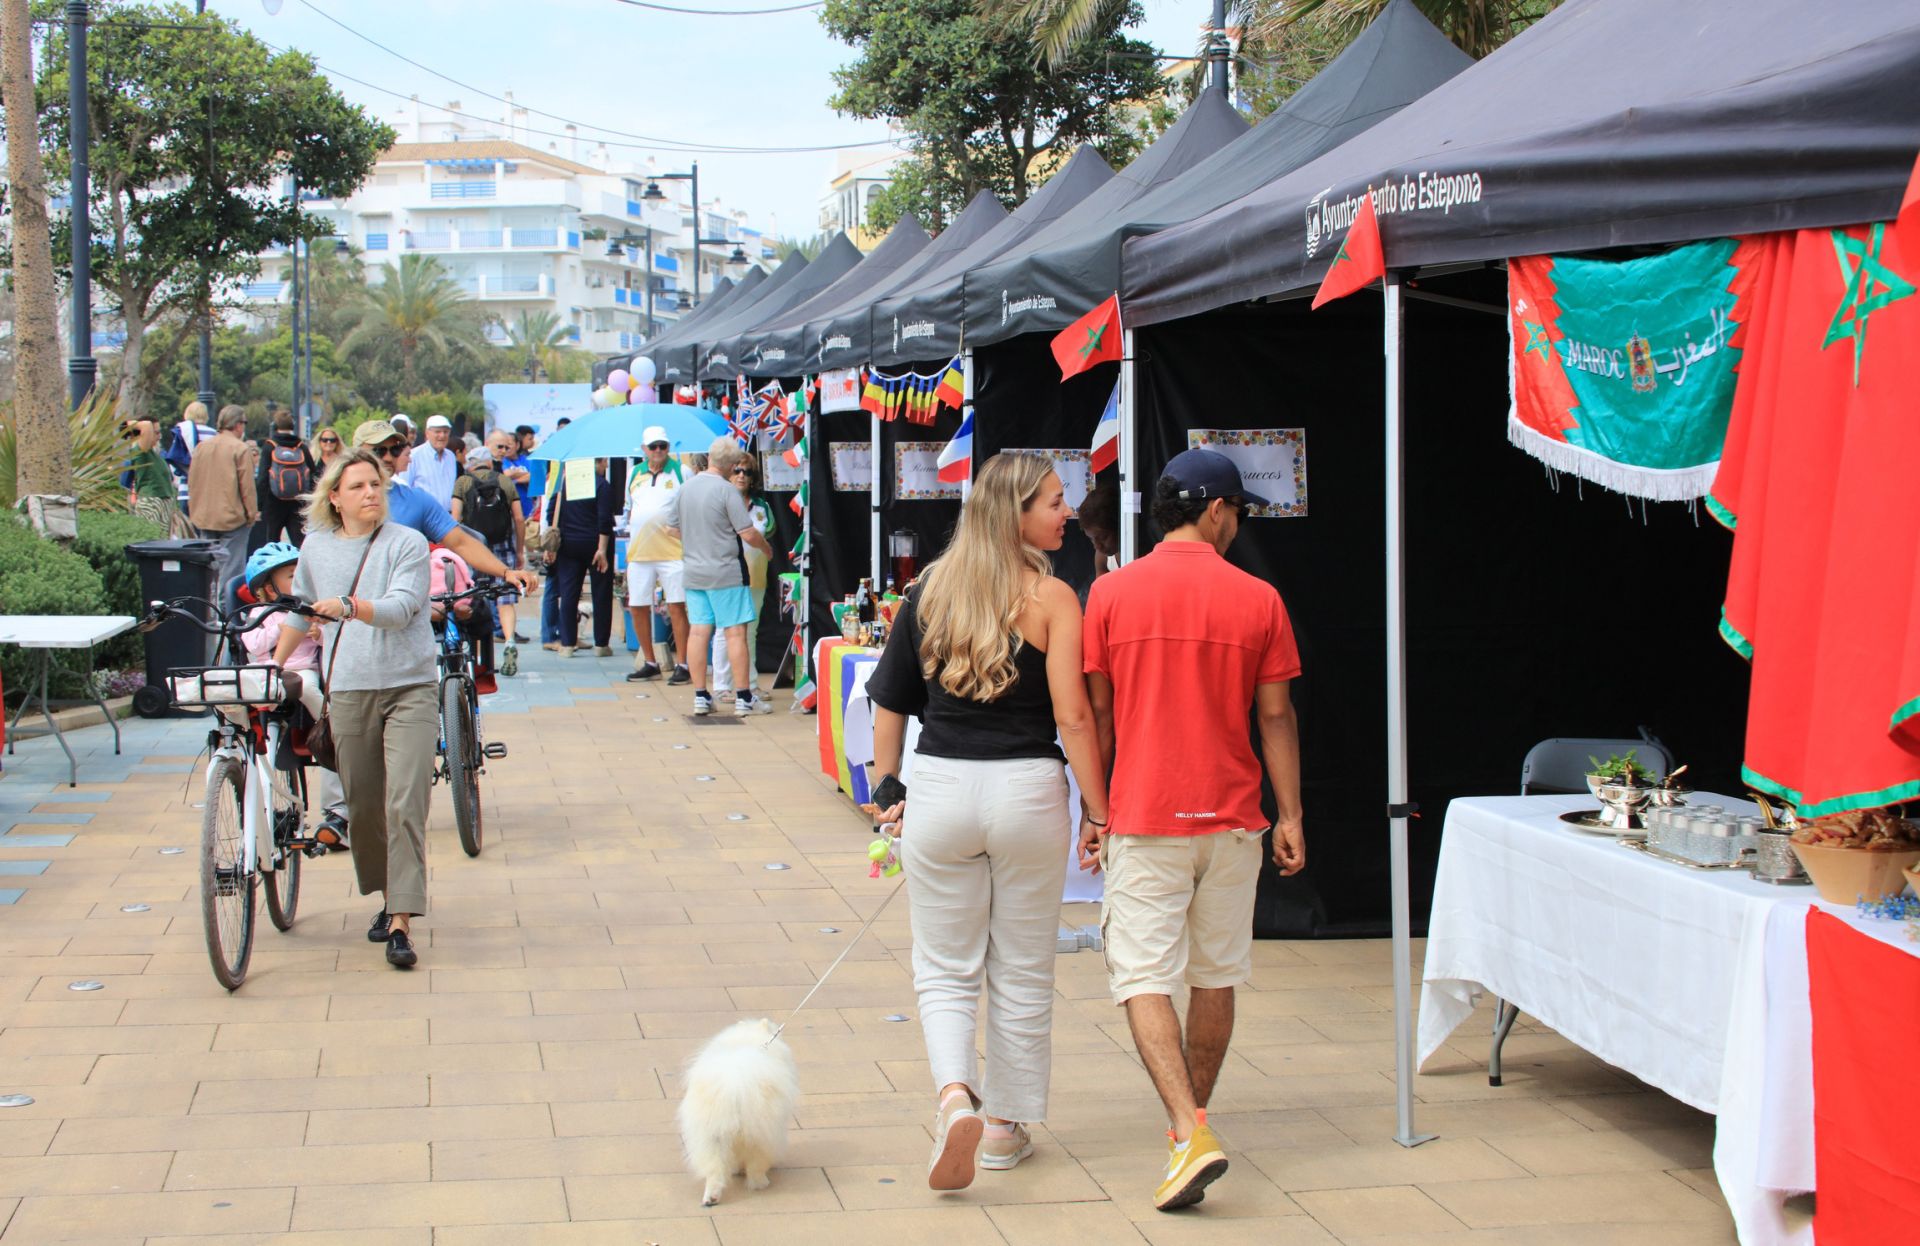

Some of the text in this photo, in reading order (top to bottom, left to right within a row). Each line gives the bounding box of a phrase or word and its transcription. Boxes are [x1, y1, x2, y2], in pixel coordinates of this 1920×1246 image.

[1322, 171, 1482, 240] Ayuntaento de Estepona
[1566, 338, 1626, 380] MAROC
[1653, 306, 1726, 387] المغرب
[1239, 470, 1282, 481] ruecos
